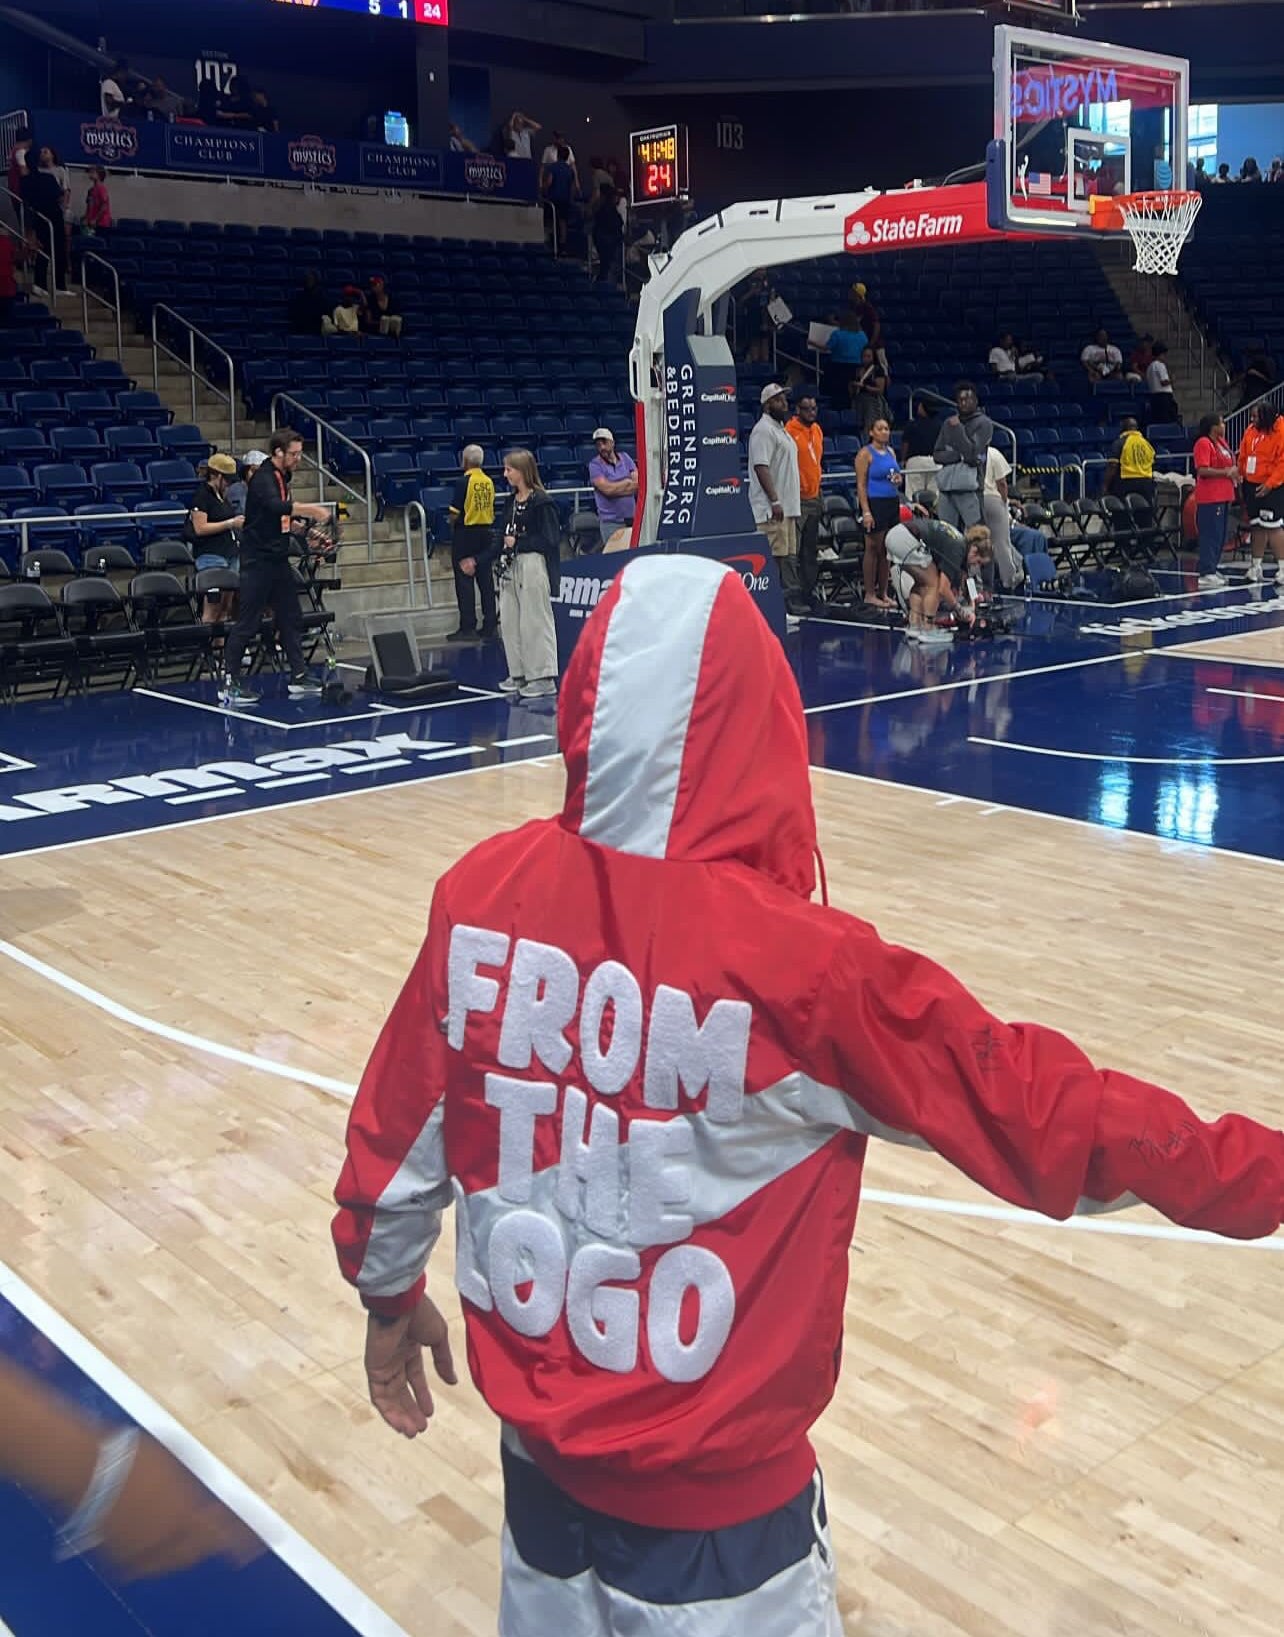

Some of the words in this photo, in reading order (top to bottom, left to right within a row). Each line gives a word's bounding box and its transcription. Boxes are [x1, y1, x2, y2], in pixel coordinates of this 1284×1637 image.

[423, 3, 441, 19] 24
[174, 135, 255, 152] CHAMPIONS
[717, 122, 744, 149] 103
[199, 150, 233, 161] CLUB
[367, 154, 437, 167] CHAMPIONS
[387, 166, 417, 177] CLUB
[648, 164, 671, 192] 24
[678, 364, 697, 524] GREENBERG
[447, 923, 753, 1123] FROM
[485, 1072, 695, 1247] THE
[450, 1175, 736, 1384] LOGO
